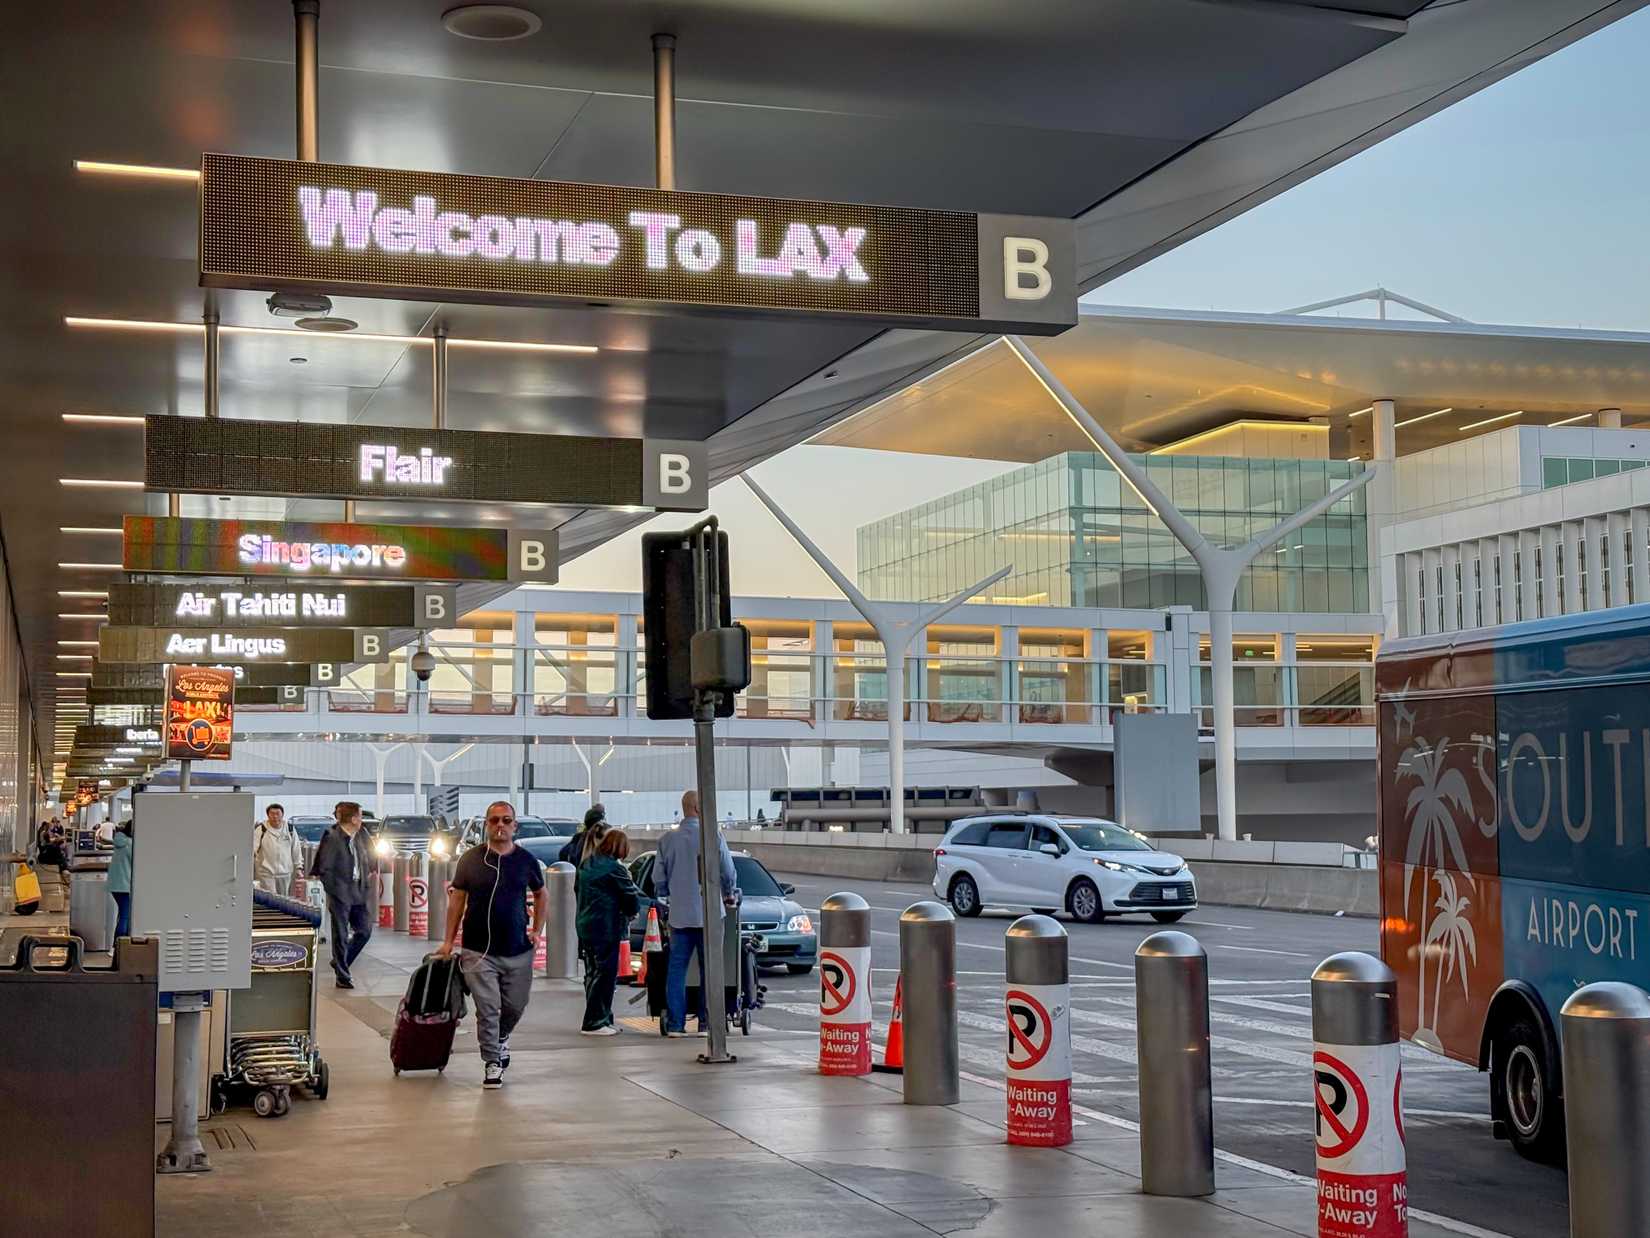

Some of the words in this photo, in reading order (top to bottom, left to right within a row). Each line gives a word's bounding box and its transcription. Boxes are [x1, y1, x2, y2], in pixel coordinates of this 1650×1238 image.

[298, 185, 621, 267] Welcome
[628, 210, 722, 274] To
[736, 218, 870, 283] LAX
[1003, 236, 1053, 300] B
[359, 444, 453, 485] Flair
[659, 453, 693, 494] B
[239, 534, 407, 572] Singapore
[520, 540, 546, 572] B
[176, 592, 216, 617] Air
[220, 592, 297, 617] Tahiti
[302, 593, 346, 617] Nui
[425, 594, 446, 619] B
[166, 633, 208, 655] Aer
[210, 634, 287, 657] Lingus
[362, 635, 380, 656] B
[317, 663, 333, 681] B
[1527, 896, 1638, 960] AIRPORT
[821, 1041, 860, 1056] -Away
[1317, 1202, 1378, 1229] -Away
